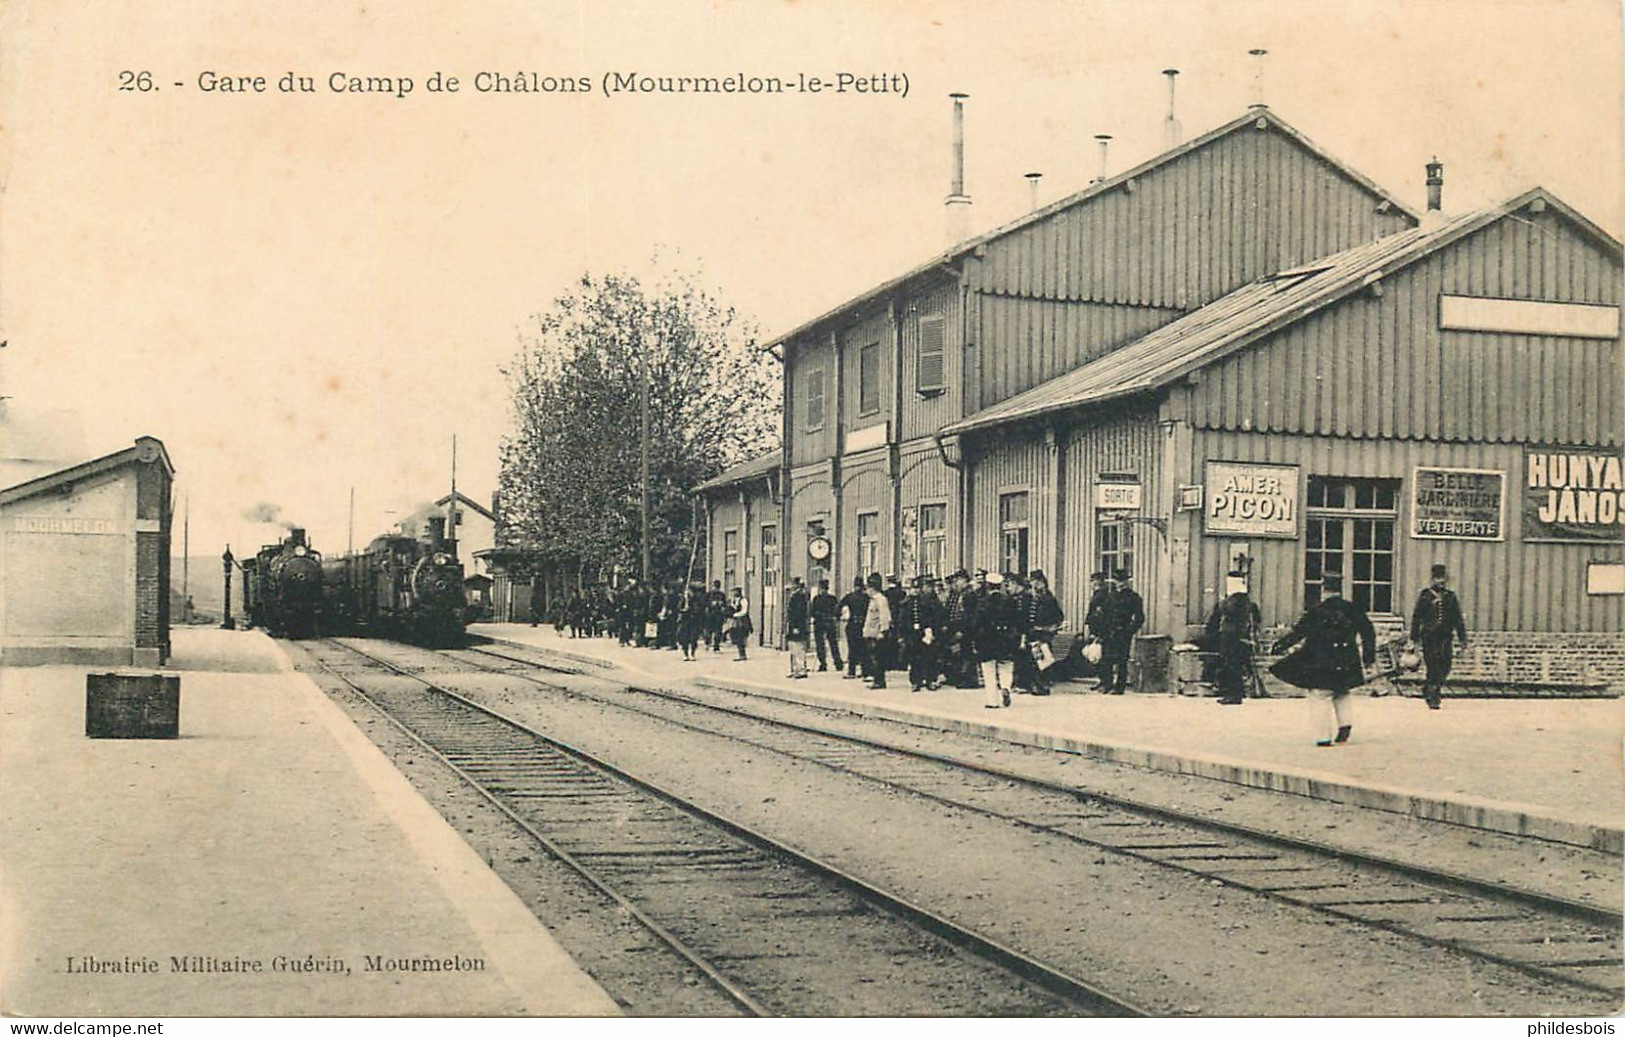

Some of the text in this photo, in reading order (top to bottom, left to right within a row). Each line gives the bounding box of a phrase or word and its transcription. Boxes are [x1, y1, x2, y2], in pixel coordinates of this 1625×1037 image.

[1434, 473, 1485, 490] BELLE
[1528, 453, 1625, 490] HUNYA
[1104, 488, 1134, 504] SORTIE
[1223, 473, 1282, 496] AMER
[1210, 494, 1293, 521] PICON
